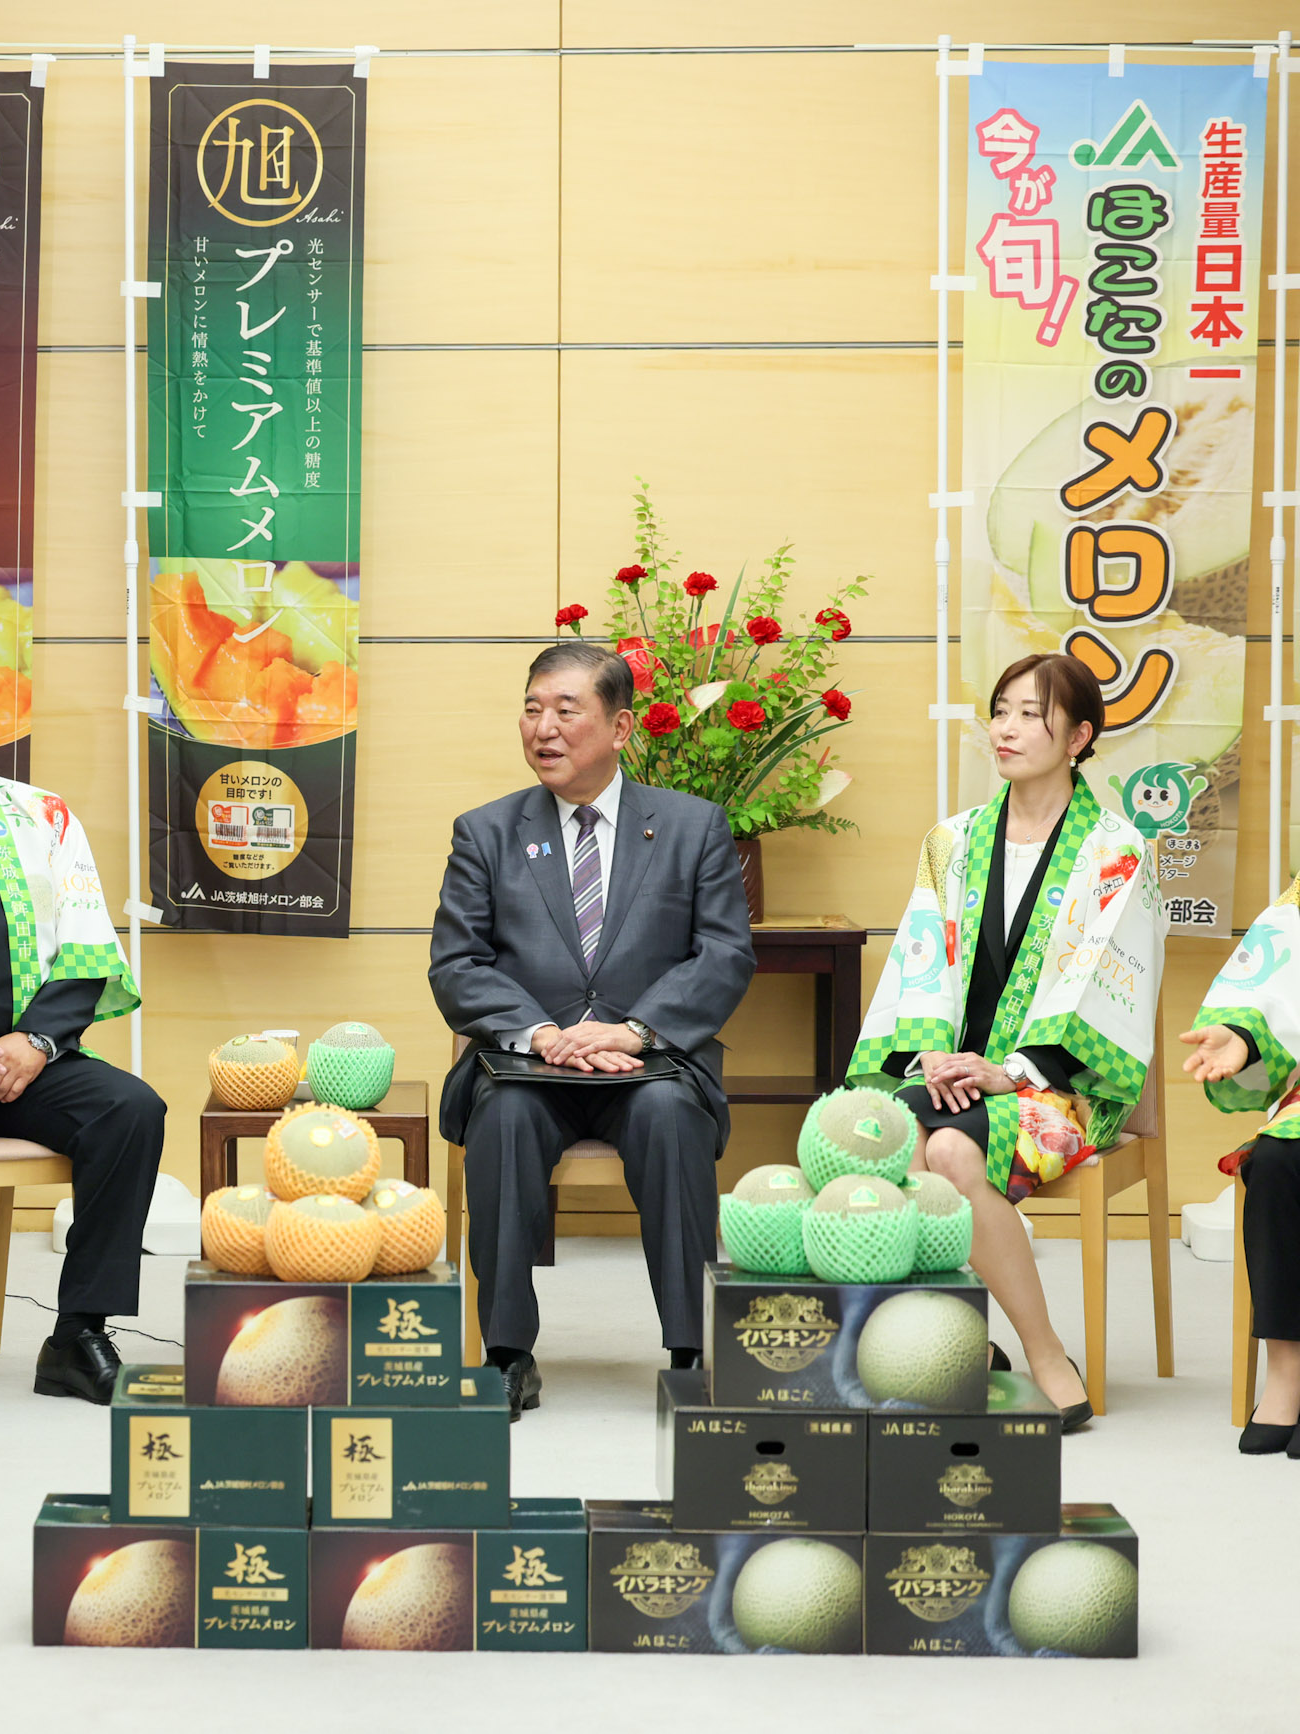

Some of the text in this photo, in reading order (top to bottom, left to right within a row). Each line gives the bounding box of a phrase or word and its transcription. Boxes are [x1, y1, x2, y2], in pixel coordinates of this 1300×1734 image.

[207, 117, 302, 210] 旭
[296, 207, 344, 223] Asahi
[191, 236, 209, 438] 甘いメロンに情熱をかけて
[304, 238, 324, 489] 光センサーで基準値以上の糖度
[225, 239, 294, 643] プレミアムメロン
[219, 773, 282, 788] 甘いメロンの
[226, 787, 272, 800] 目印です!
[1167, 839, 1200, 850] ほこまる
[1159, 856, 1196, 867] メージ
[210, 890, 325, 909] JA茨城旭村メロン部会
[1165, 898, 1216, 924] 部会
[1001, 913, 1053, 1034] 茨城県鉾田市
[376, 1298, 439, 1340] 極
[736, 1329, 836, 1348] イバラキング
[356, 1373, 450, 1387] プレミアムメロン
[141, 1432, 184, 1461] 極
[342, 1433, 386, 1463] 極
[136, 1481, 183, 1491] プレミアム
[338, 1483, 385, 1494] プレミアム
[146, 1492, 174, 1501] メロン
[348, 1494, 375, 1503] メロン
[748, 1511, 791, 1519] HOKOTA
[943, 1513, 986, 1521] HOKOTA
[223, 1542, 286, 1584] 極
[502, 1545, 564, 1587] 極
[612, 1575, 712, 1594] イバラキング
[888, 1579, 988, 1598] イバラキング
[203, 1616, 297, 1631] プレミアムメロン
[482, 1619, 576, 1634] プレミアムメロン
